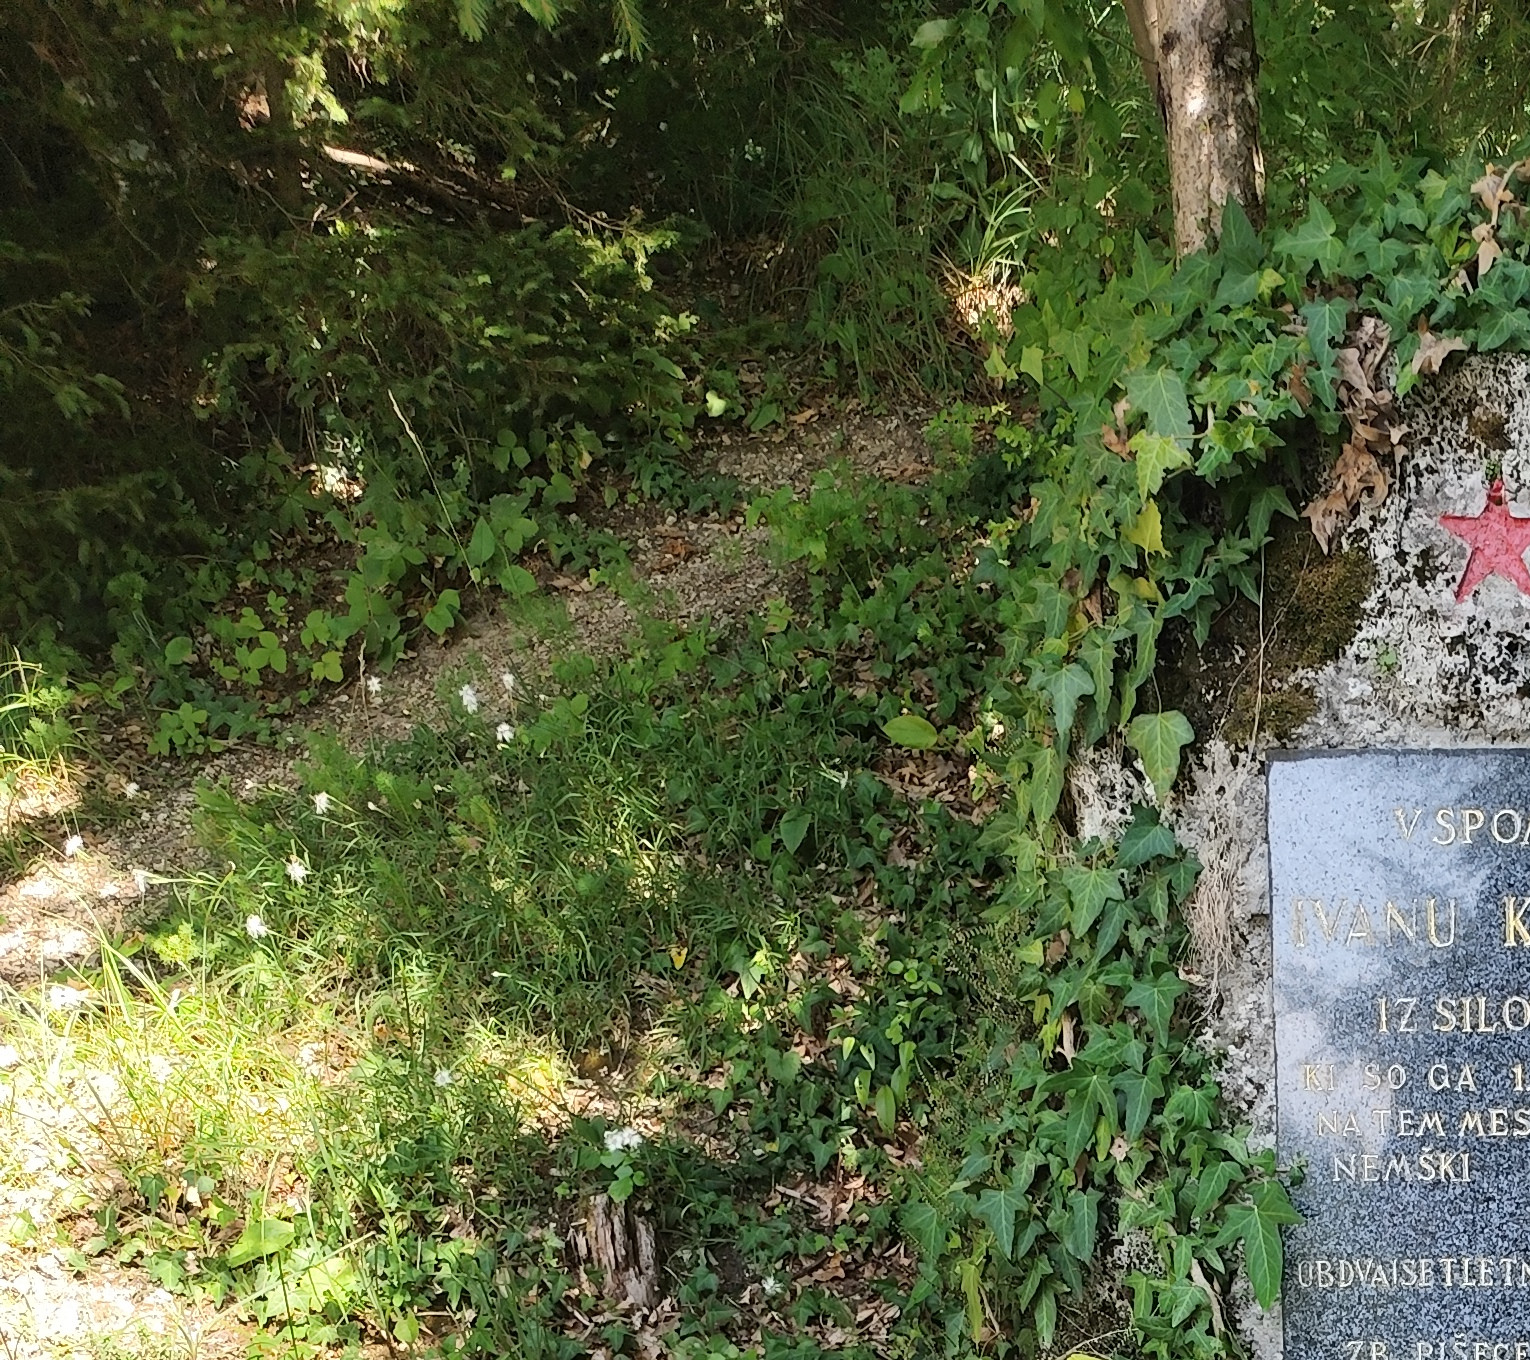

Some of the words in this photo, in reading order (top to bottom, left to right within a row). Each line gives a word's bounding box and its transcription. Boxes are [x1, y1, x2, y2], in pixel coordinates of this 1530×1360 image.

[1395, 809, 1422, 840] V
[1291, 897, 1458, 949] IVANU
[1379, 998, 1418, 1033] IZ
[1302, 1064, 1335, 1092] KI
[1363, 1063, 1407, 1091] SO
[1428, 1064, 1478, 1093] GA
[1316, 1110, 1363, 1137] NA
[1372, 1109, 1446, 1138] TEM
[1332, 1146, 1472, 1183] NEMŠKI
